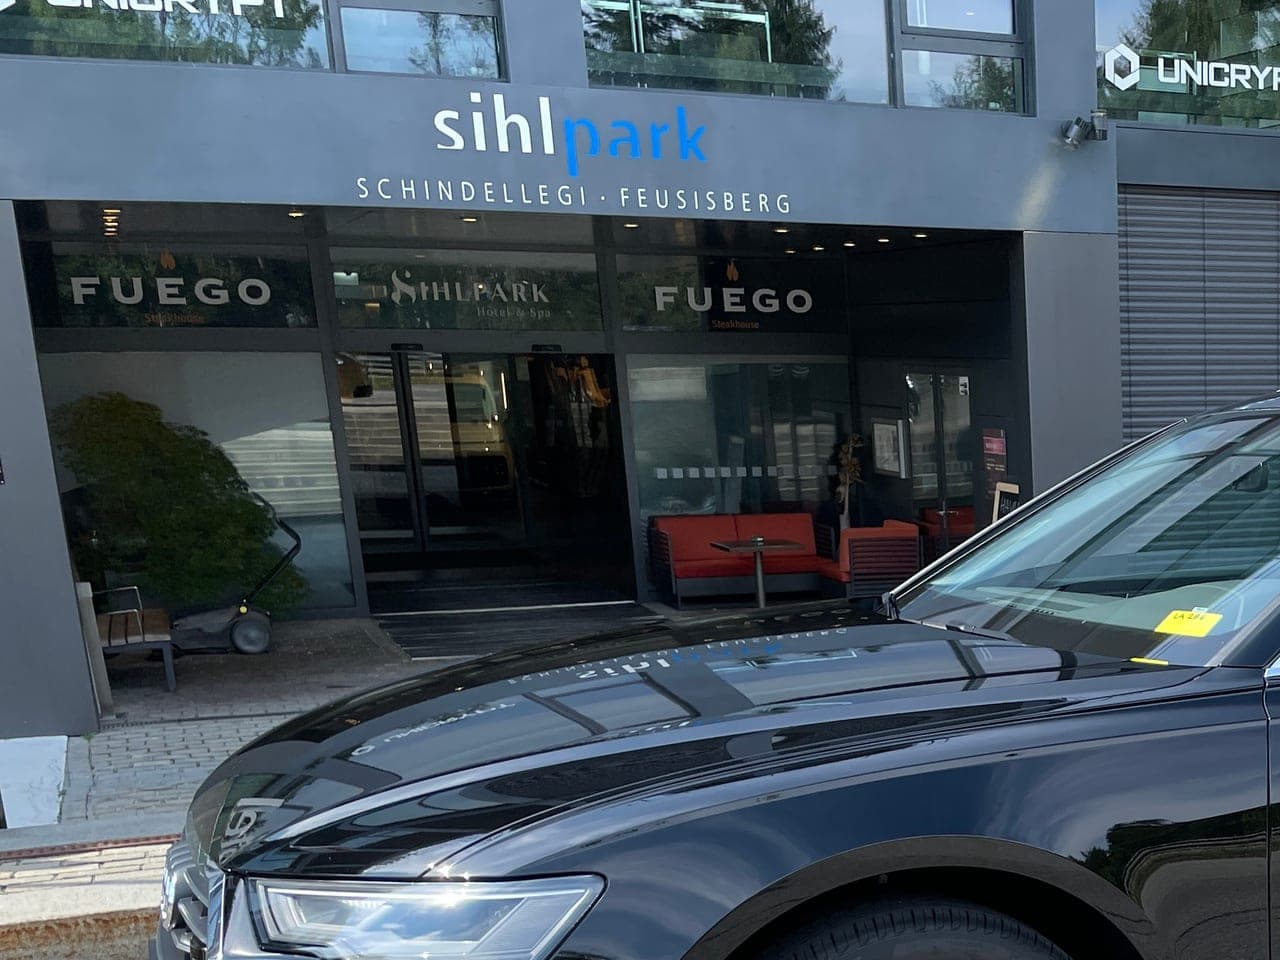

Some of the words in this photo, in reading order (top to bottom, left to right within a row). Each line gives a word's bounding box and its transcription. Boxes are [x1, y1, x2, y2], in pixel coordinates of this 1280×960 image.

[432, 91, 708, 177] sihlpark
[356, 177, 587, 207] SCHINDELLEGI
[620, 187, 791, 214] FEUSISBERG
[70, 276, 272, 306] FUEGO
[654, 285, 813, 314] FUEGO
